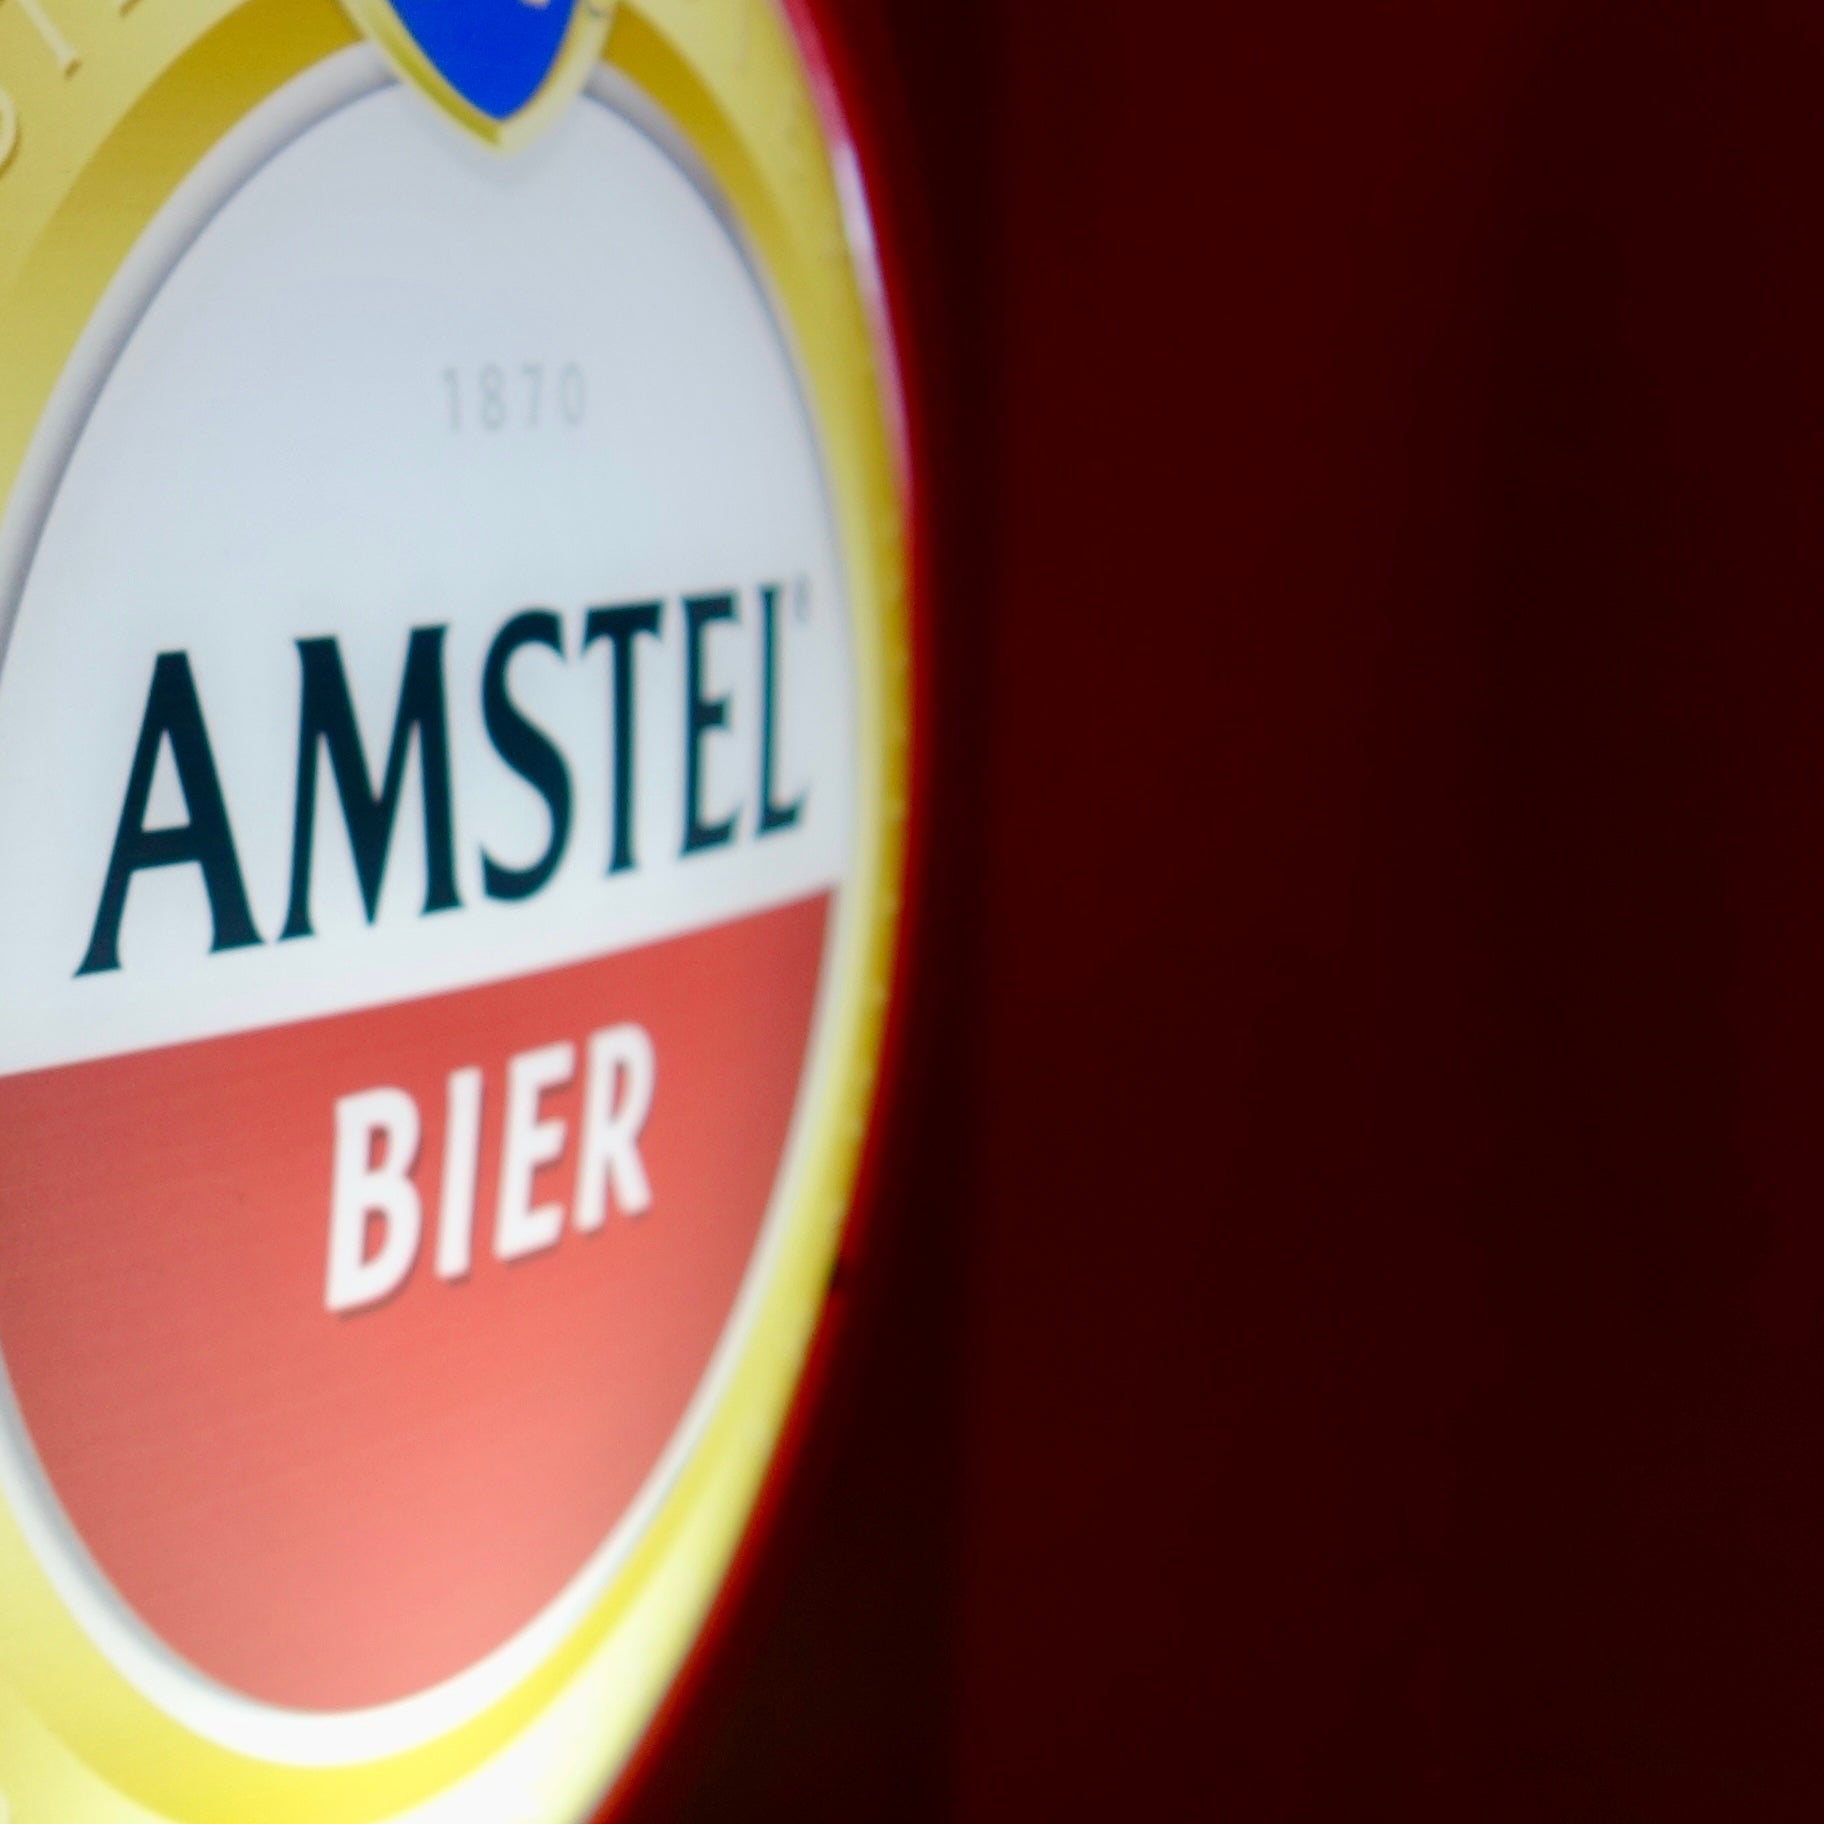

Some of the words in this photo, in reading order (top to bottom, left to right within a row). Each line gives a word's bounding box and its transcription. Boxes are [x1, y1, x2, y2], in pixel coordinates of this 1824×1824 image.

[441, 360, 586, 432] 1870
[72, 582, 805, 979] AMSTEL
[323, 1021, 658, 1315] BIER
